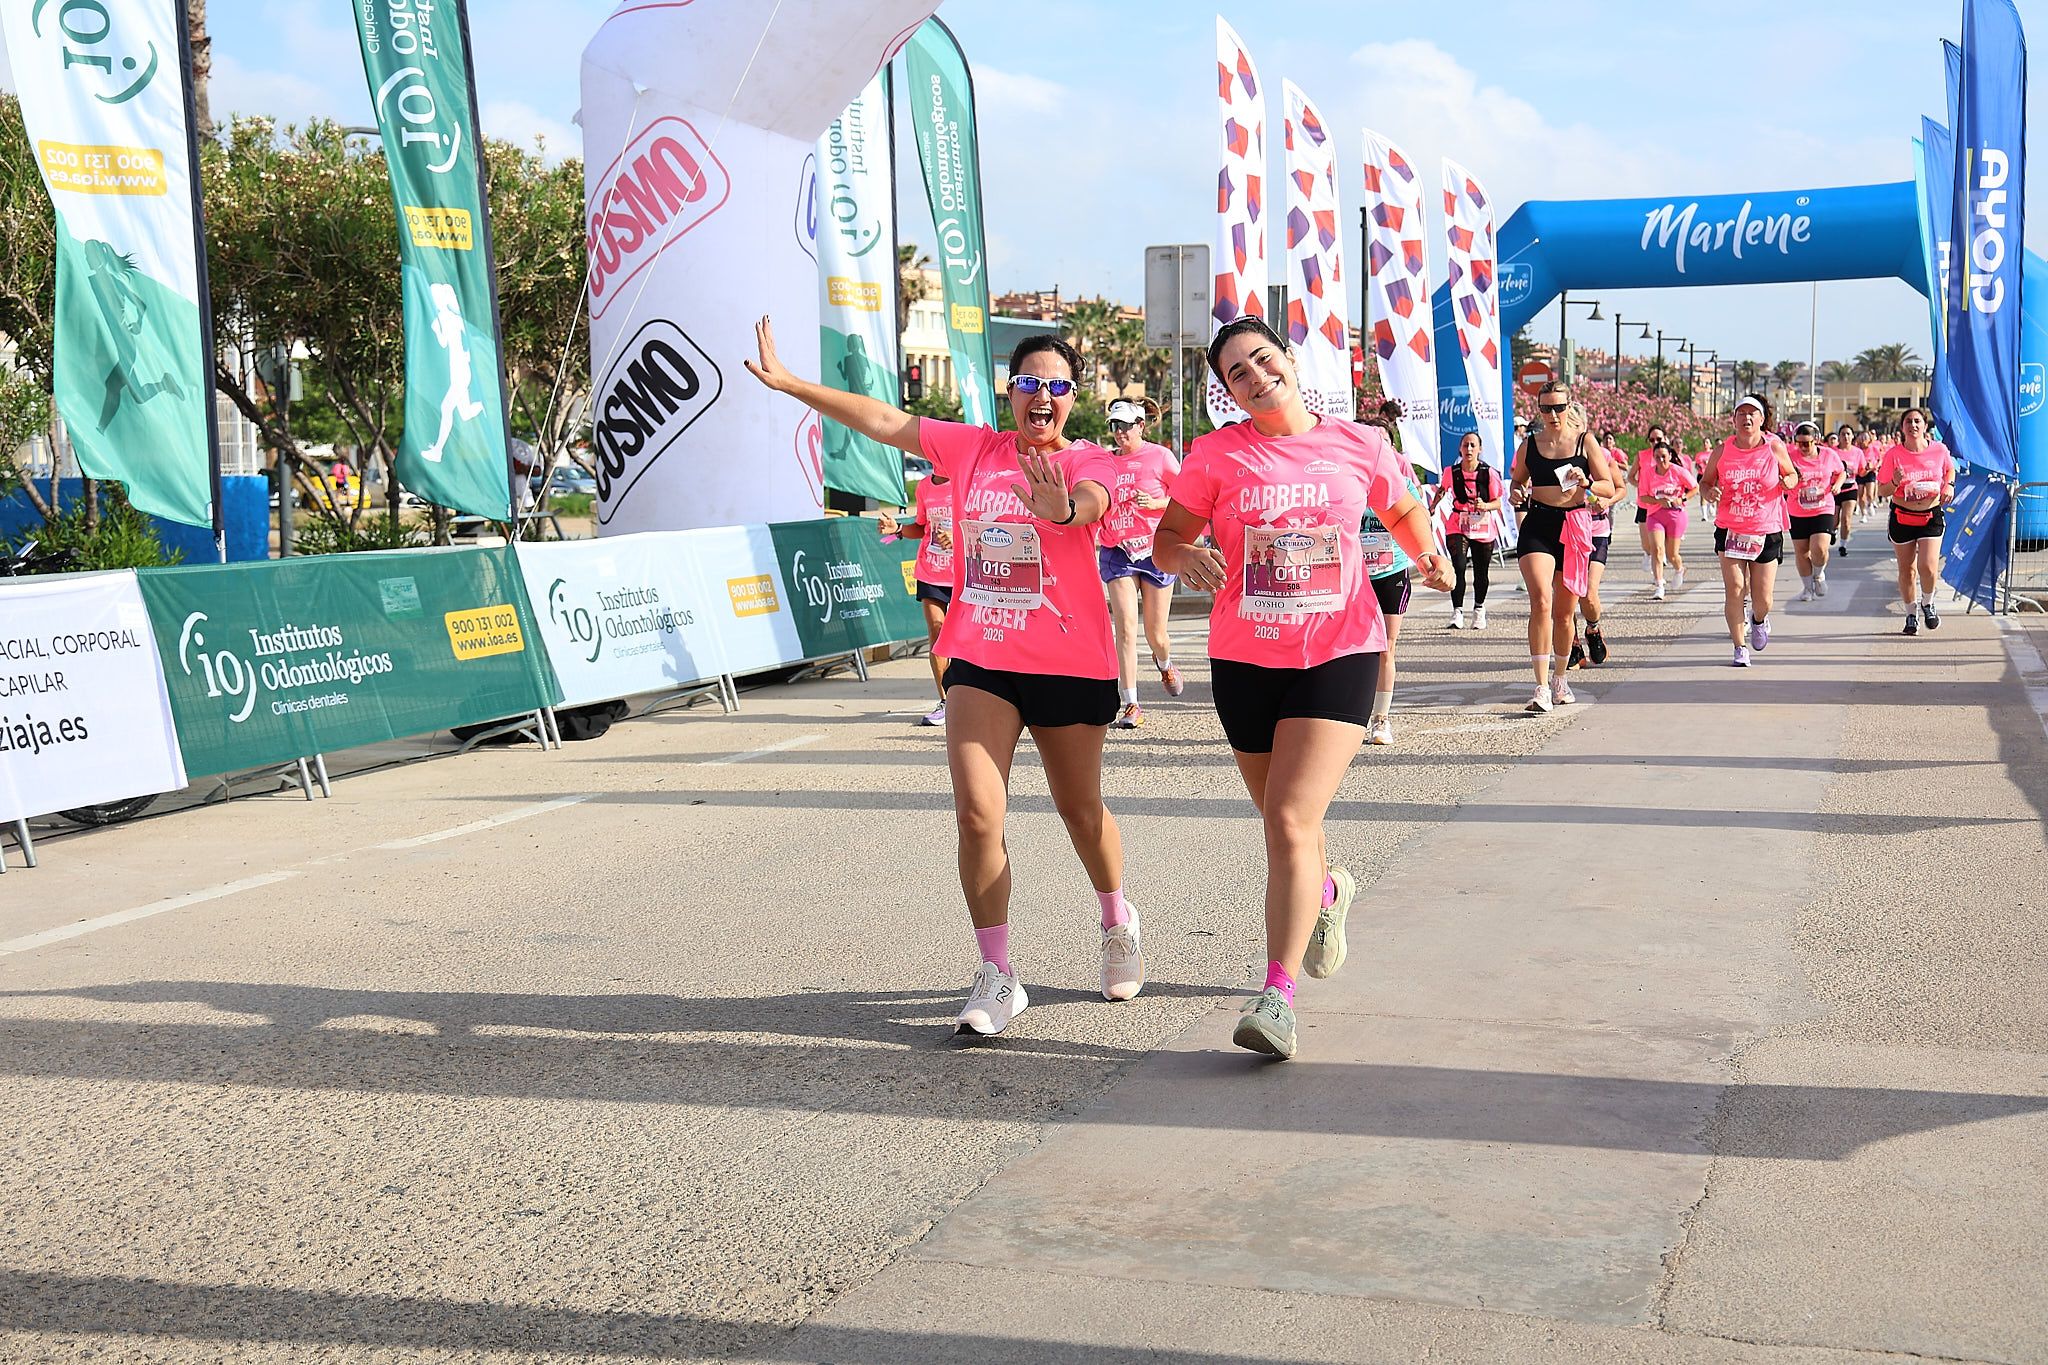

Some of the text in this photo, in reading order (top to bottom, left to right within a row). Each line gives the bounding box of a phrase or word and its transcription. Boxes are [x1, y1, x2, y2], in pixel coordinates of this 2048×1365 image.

[1641, 199, 1811, 273] Marlene
[1499, 273, 1529, 291] rlene
[1726, 469, 1760, 480] CARRERA
[1240, 482, 1330, 513] CARRERA
[825, 560, 863, 581] Institutos
[982, 560, 1012, 577] 016
[1275, 565, 1311, 582] 016
[596, 587, 660, 611] Institutos
[731, 586, 747, 598] 900
[758, 581, 773, 593] 002
[1254, 589, 1275, 597] CARRERA
[1004, 597, 1032, 605] Santander
[1254, 600, 1333, 609] OYSHO Santander
[452, 613, 514, 634] 900 131 002
[605, 607, 694, 639] Odontológicos
[1254, 625, 1280, 640] 2026
[53, 629, 141, 655] CORPORAL
[249, 623, 343, 656] Institutos
[457, 632, 519, 652] www.ioa.es
[983, 627, 1004, 642] 2026
[261, 649, 394, 691] Odontológicos
[0, 671, 68, 698] CAPILAR
[307, 691, 349, 710] dentales
